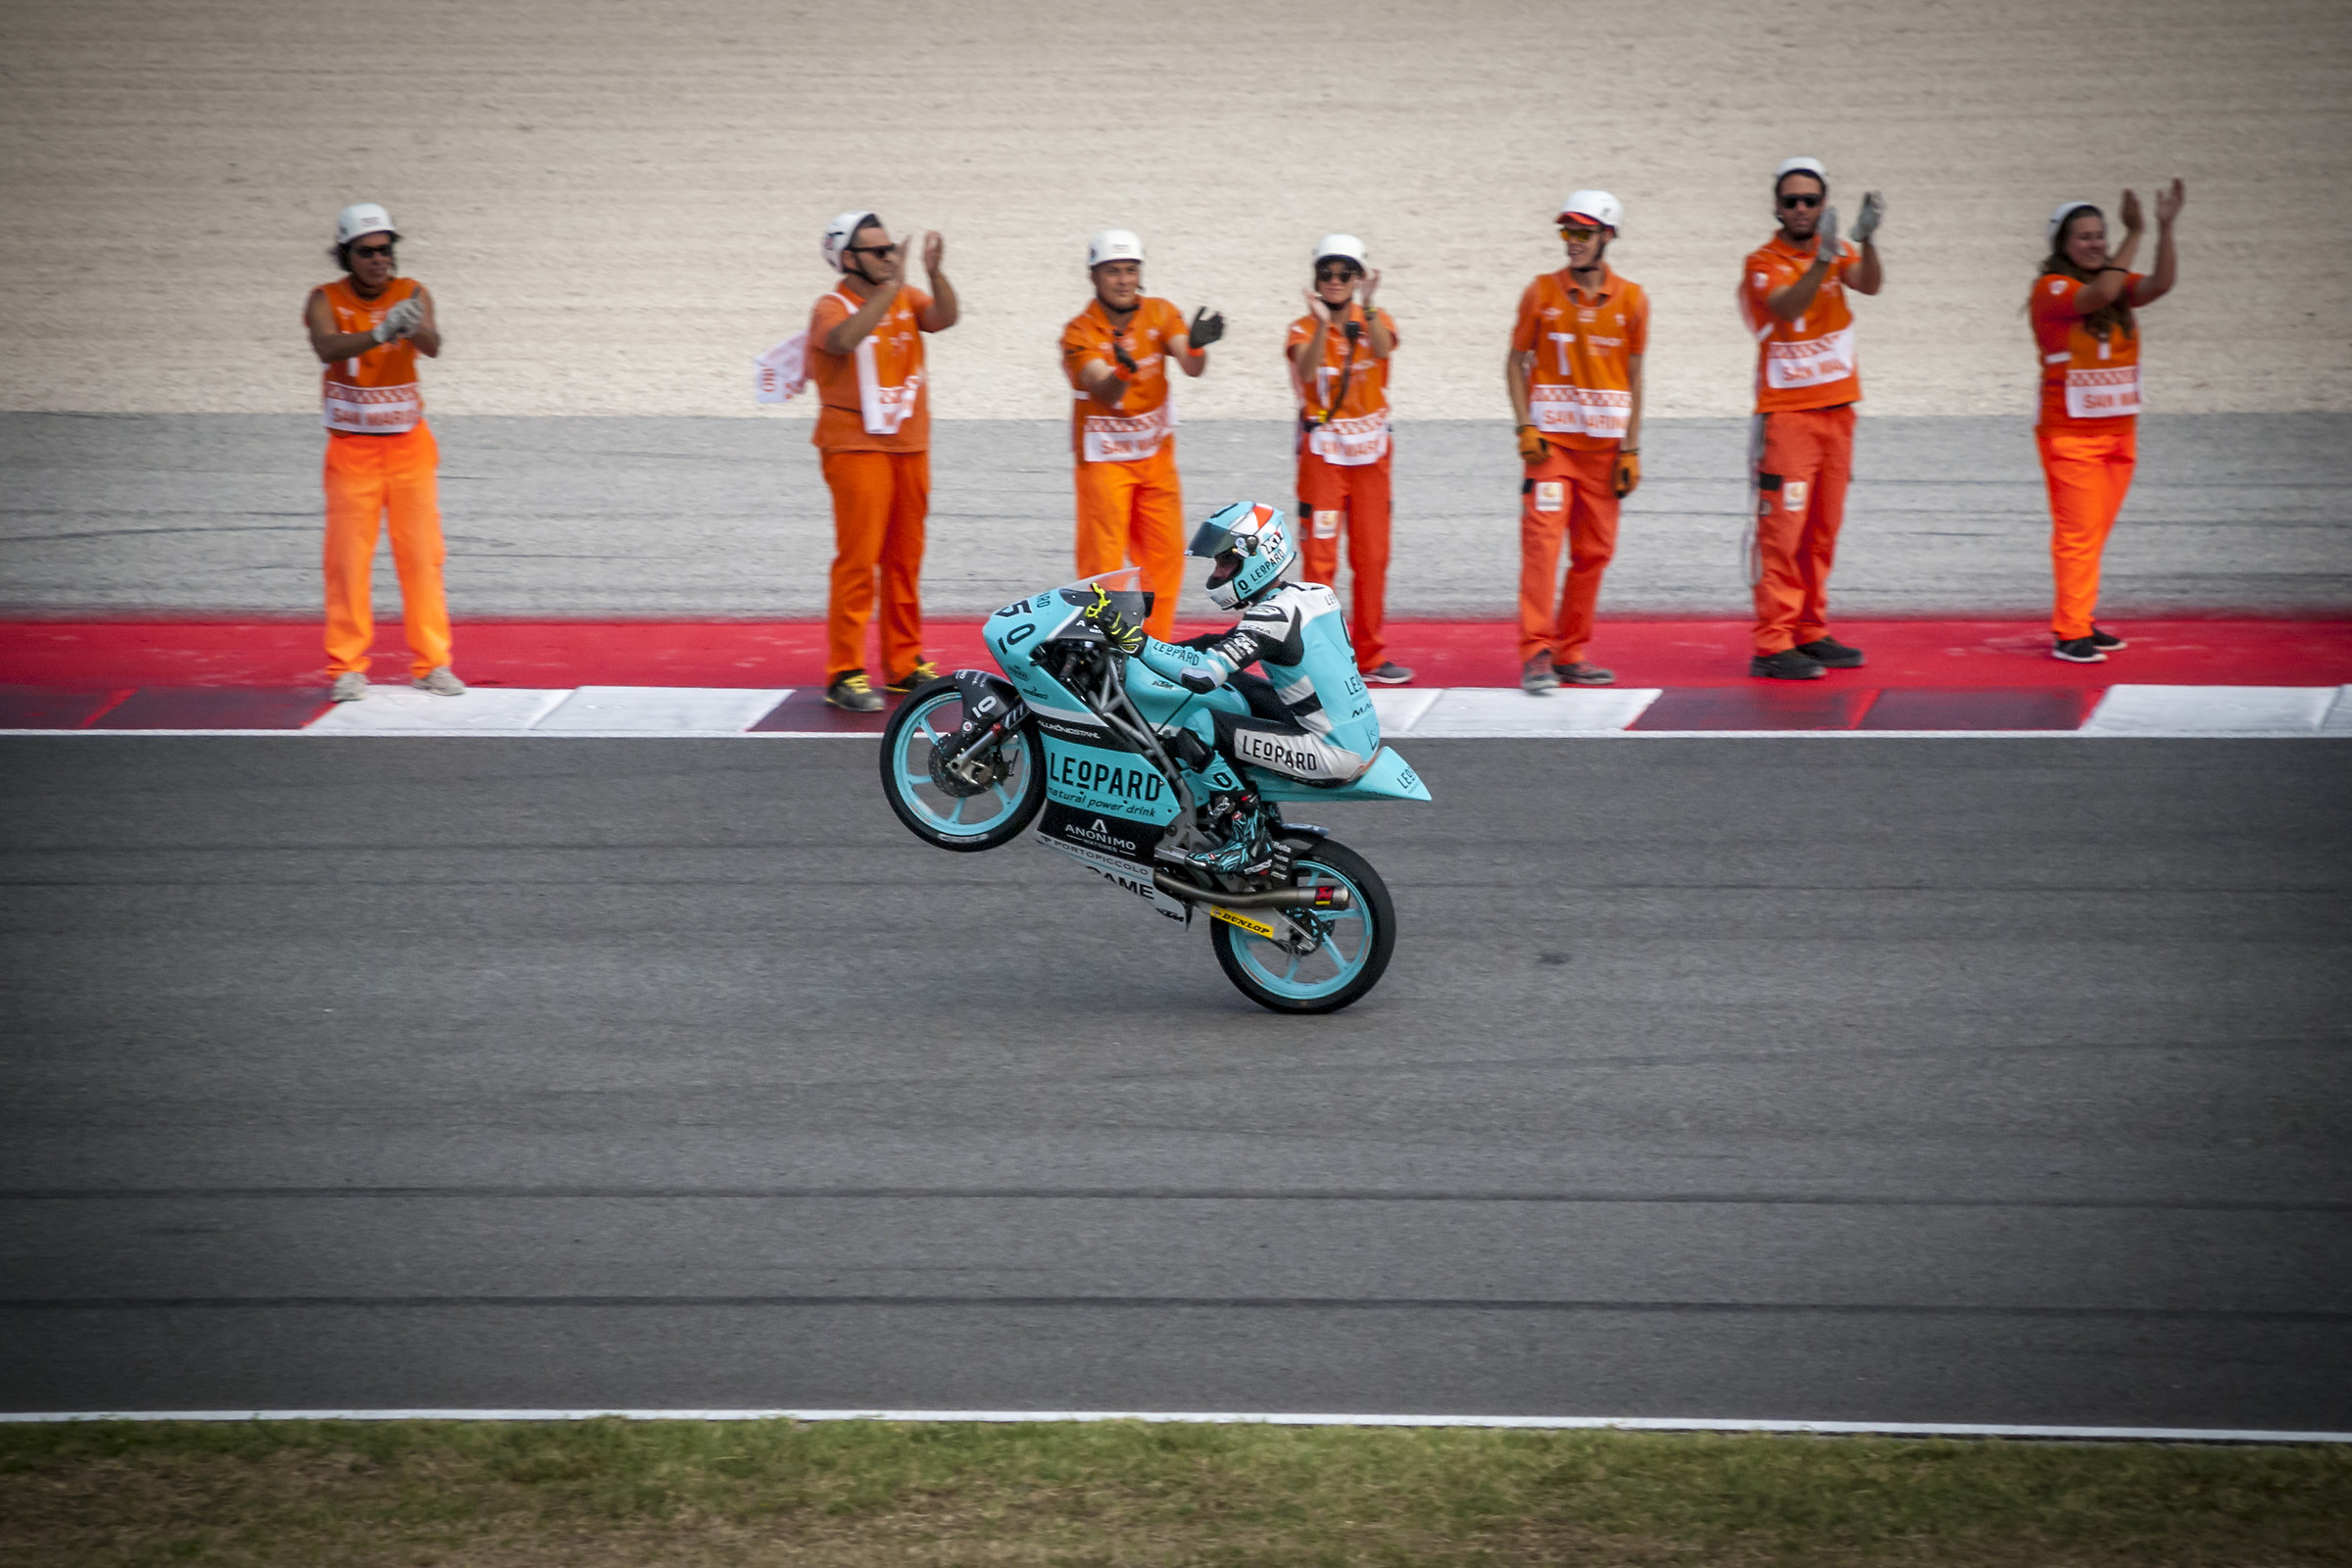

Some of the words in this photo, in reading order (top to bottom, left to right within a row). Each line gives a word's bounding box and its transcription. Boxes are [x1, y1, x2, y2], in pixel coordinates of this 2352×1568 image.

[1250, 549, 1285, 582] LEOPARD
[1153, 641, 1200, 666] LEOPARD
[1243, 735, 1318, 771] LEOPARD
[1050, 752, 1163, 802] LEOPARD
[1048, 786, 1087, 804] natural
[1088, 797, 1124, 811] power
[1126, 804, 1156, 817] drink
[1064, 824, 1137, 851] ANONIMO
[1054, 840, 1149, 875] PORTOPICCOLO
[1086, 865, 1154, 900] AME
[1222, 912, 1270, 934] DUNLOP
